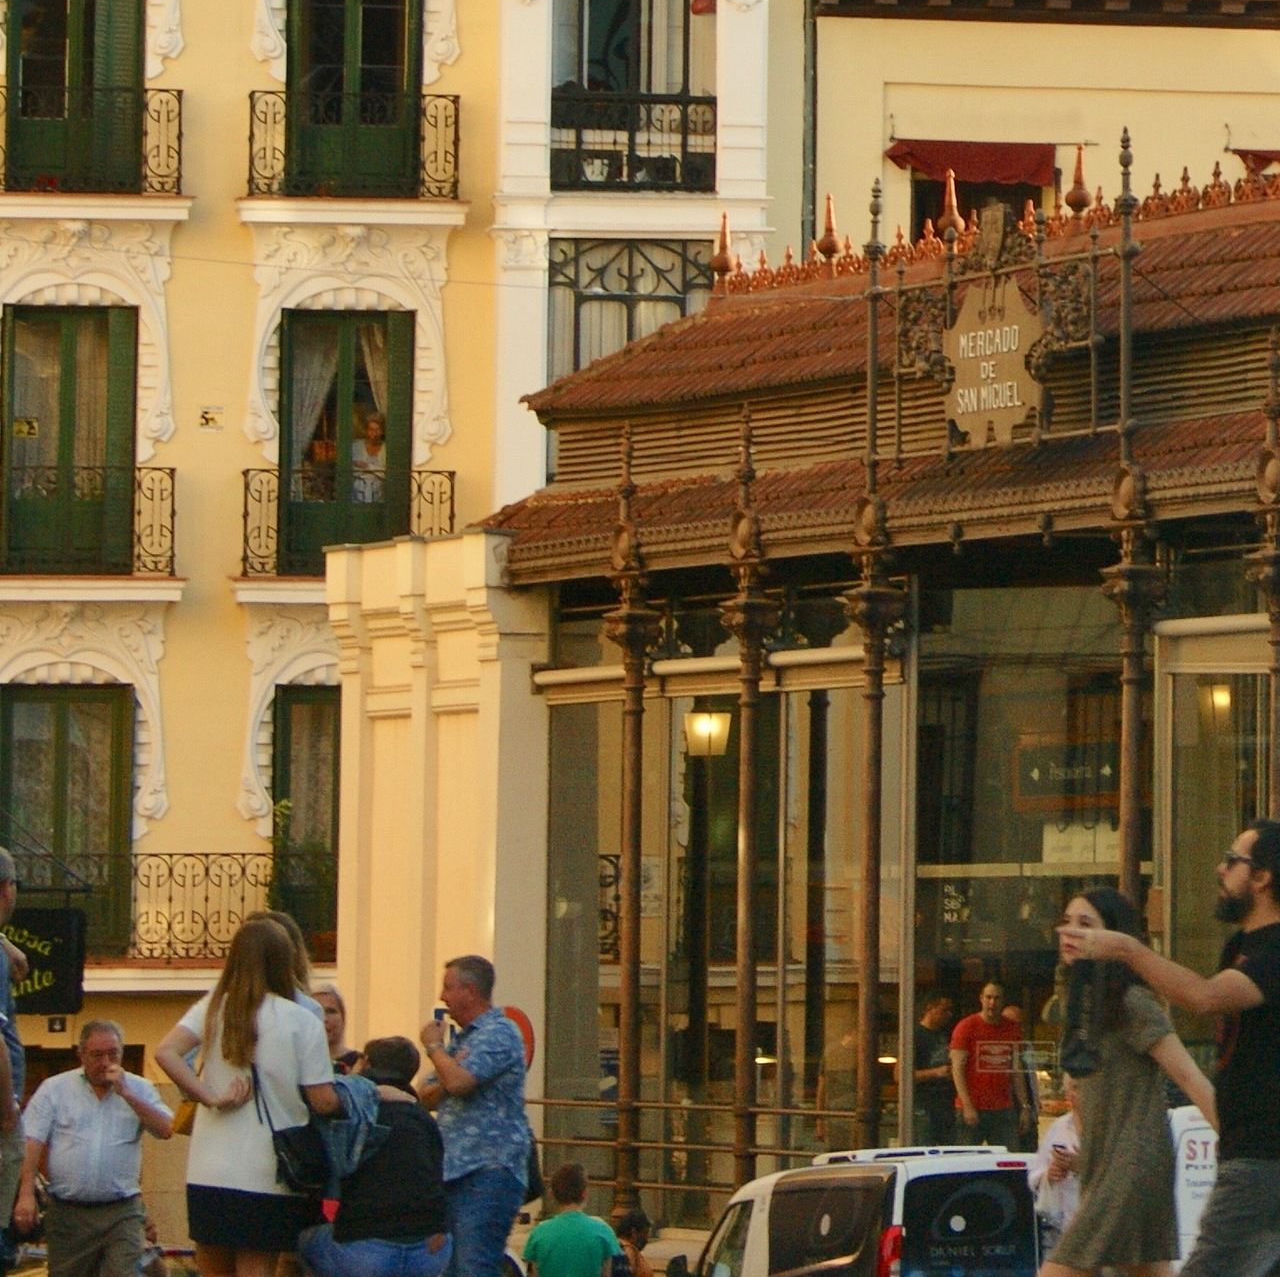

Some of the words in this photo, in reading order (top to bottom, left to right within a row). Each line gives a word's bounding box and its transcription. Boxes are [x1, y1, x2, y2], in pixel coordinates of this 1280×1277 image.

[958, 325, 1020, 359] MERCADO
[980, 361, 997, 380] DE
[957, 387, 979, 414] SAN
[980, 381, 1023, 410] MIGUEL
[1185, 1138, 1220, 1162] ST
